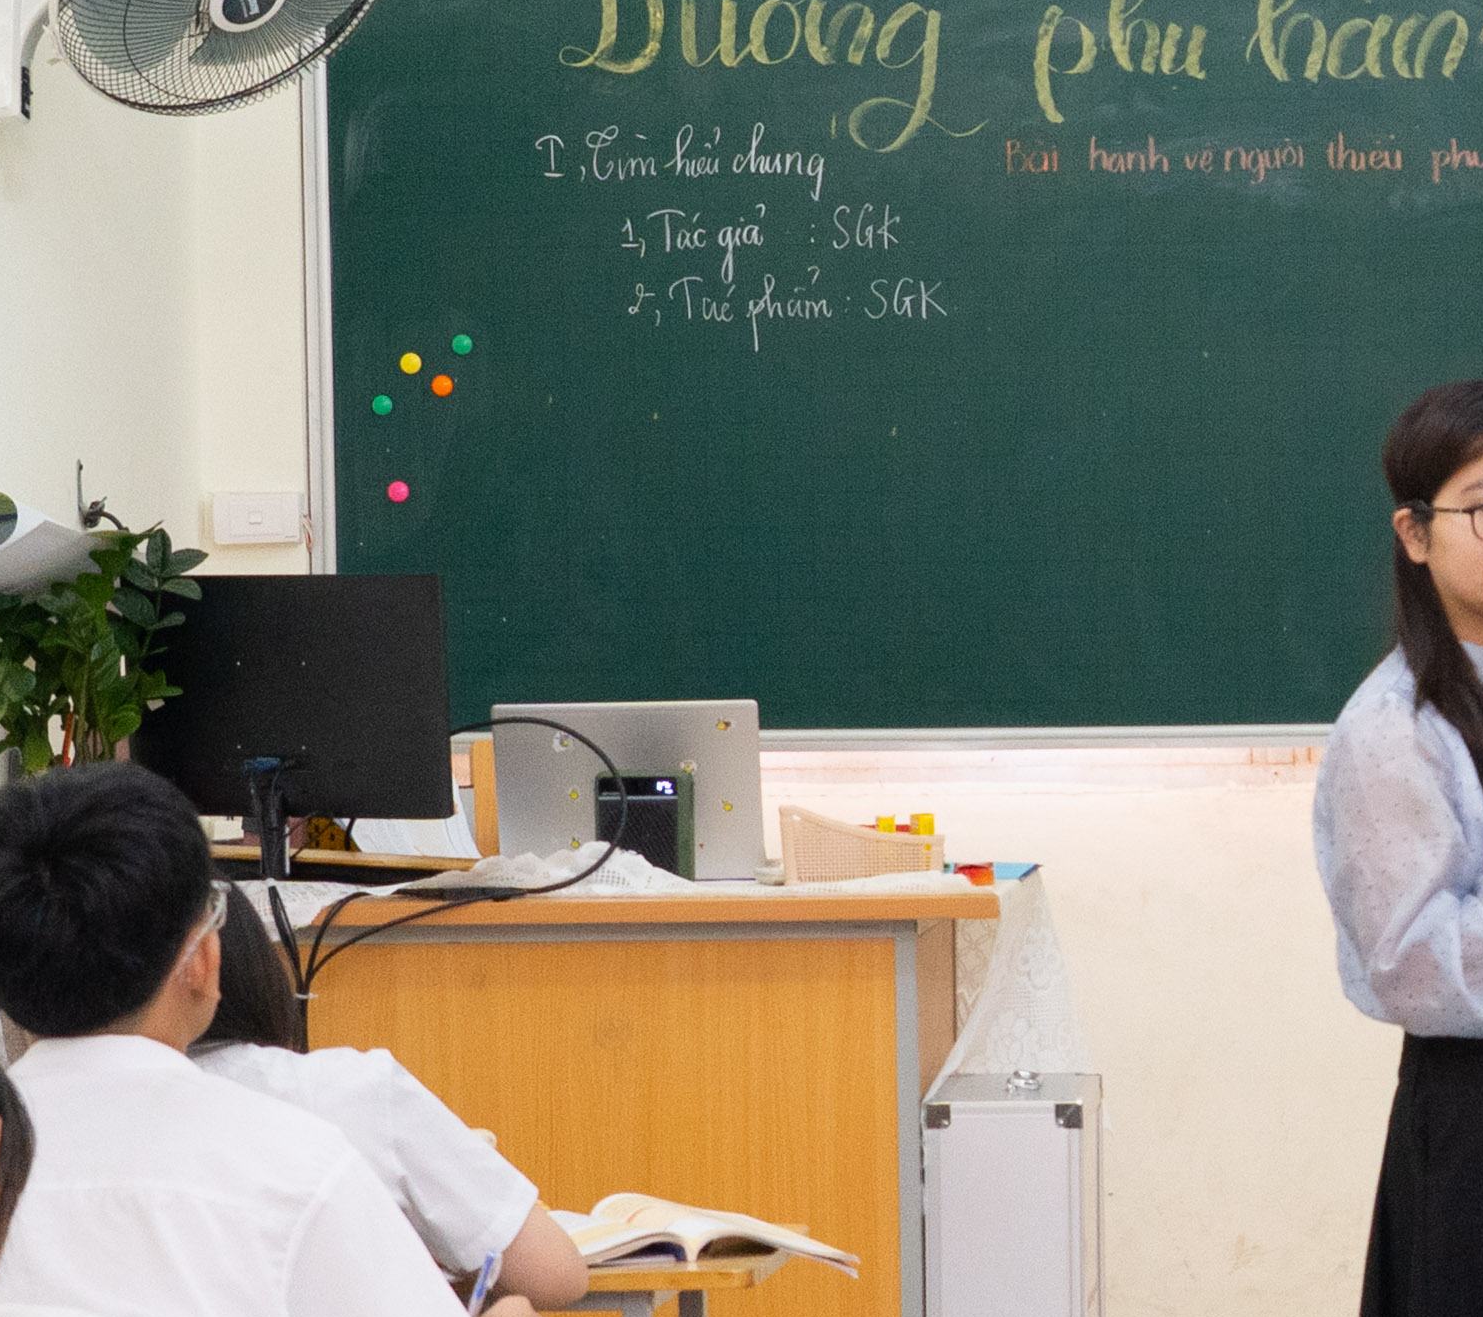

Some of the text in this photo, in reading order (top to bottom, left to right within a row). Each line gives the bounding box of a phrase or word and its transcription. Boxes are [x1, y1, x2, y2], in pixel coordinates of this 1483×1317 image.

[585, 125, 658, 181] Tìm
[664, 124, 721, 178] hiểu
[732, 122, 826, 202] chung
[647, 208, 708, 253] Tác
[718, 203, 766, 284] giả
[832, 203, 902, 251] SGK
[864, 277, 949, 321] SGK
